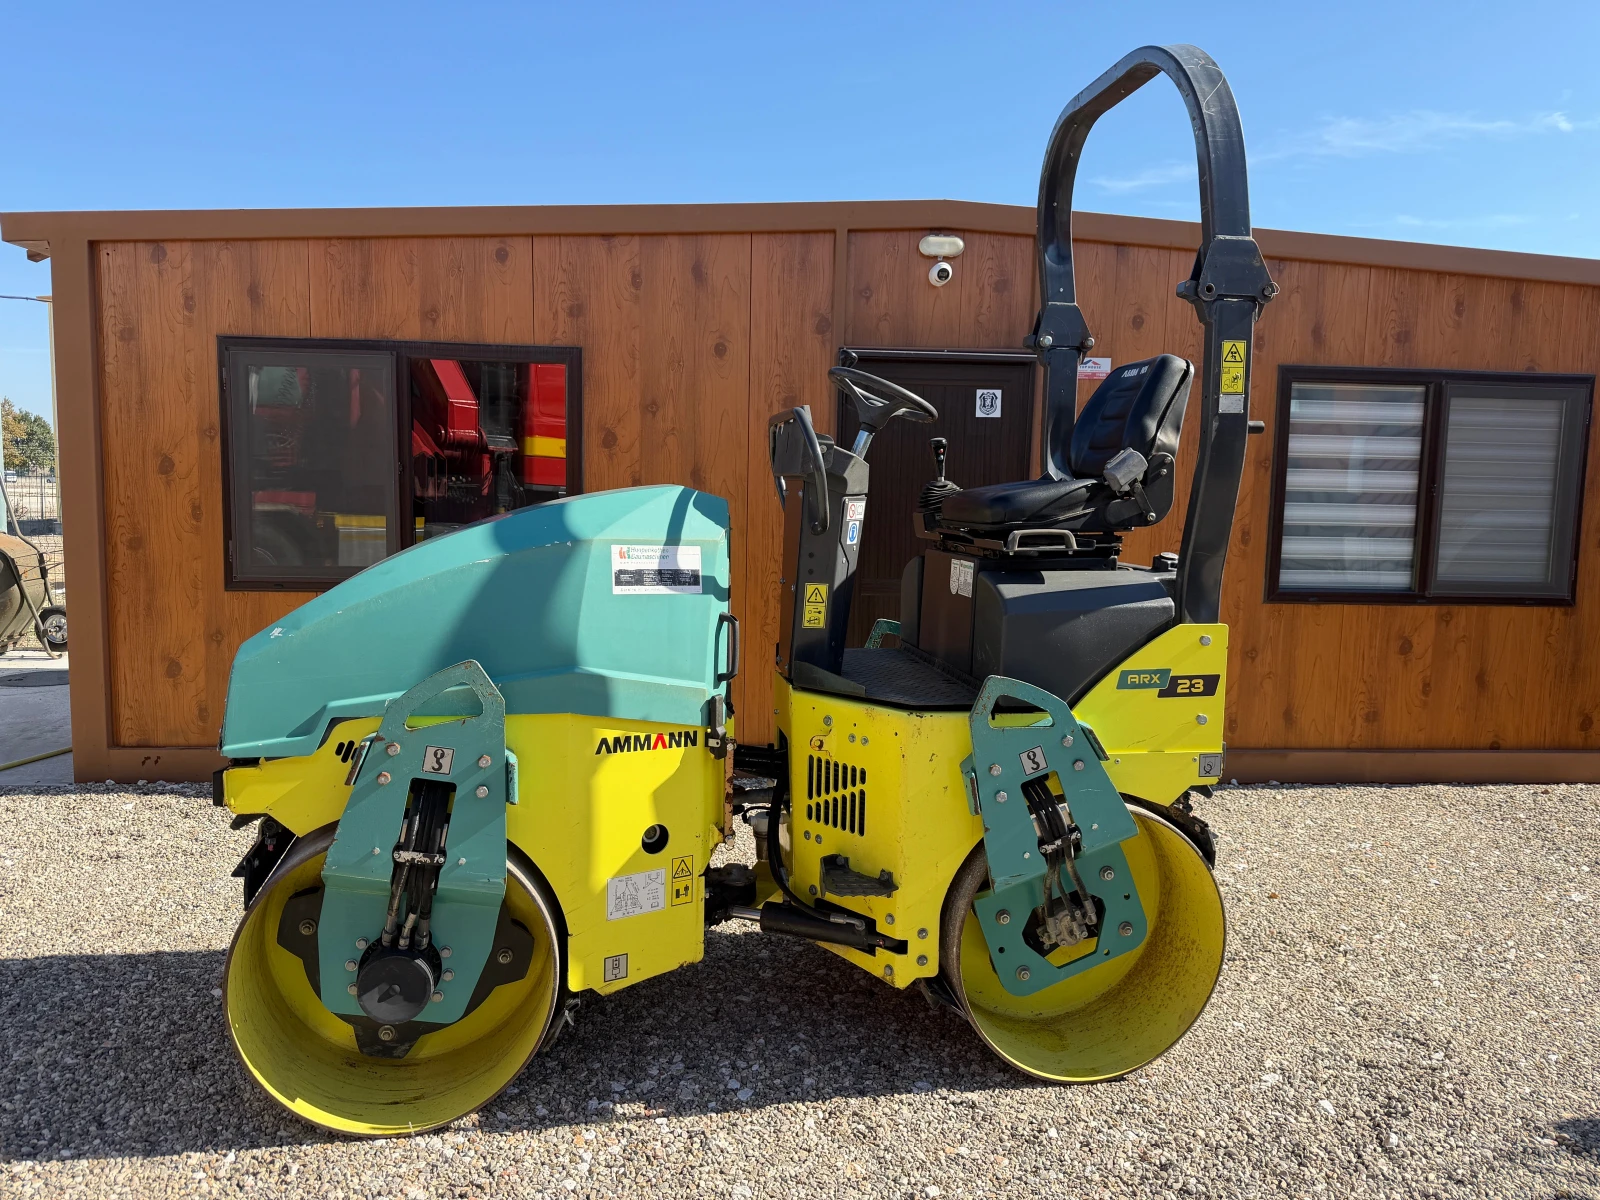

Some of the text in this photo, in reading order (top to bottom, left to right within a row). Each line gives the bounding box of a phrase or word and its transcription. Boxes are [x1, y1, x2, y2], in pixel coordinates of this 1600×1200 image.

[1127, 673, 1204, 694] ARX 23
[595, 730, 698, 755] AMMANN
